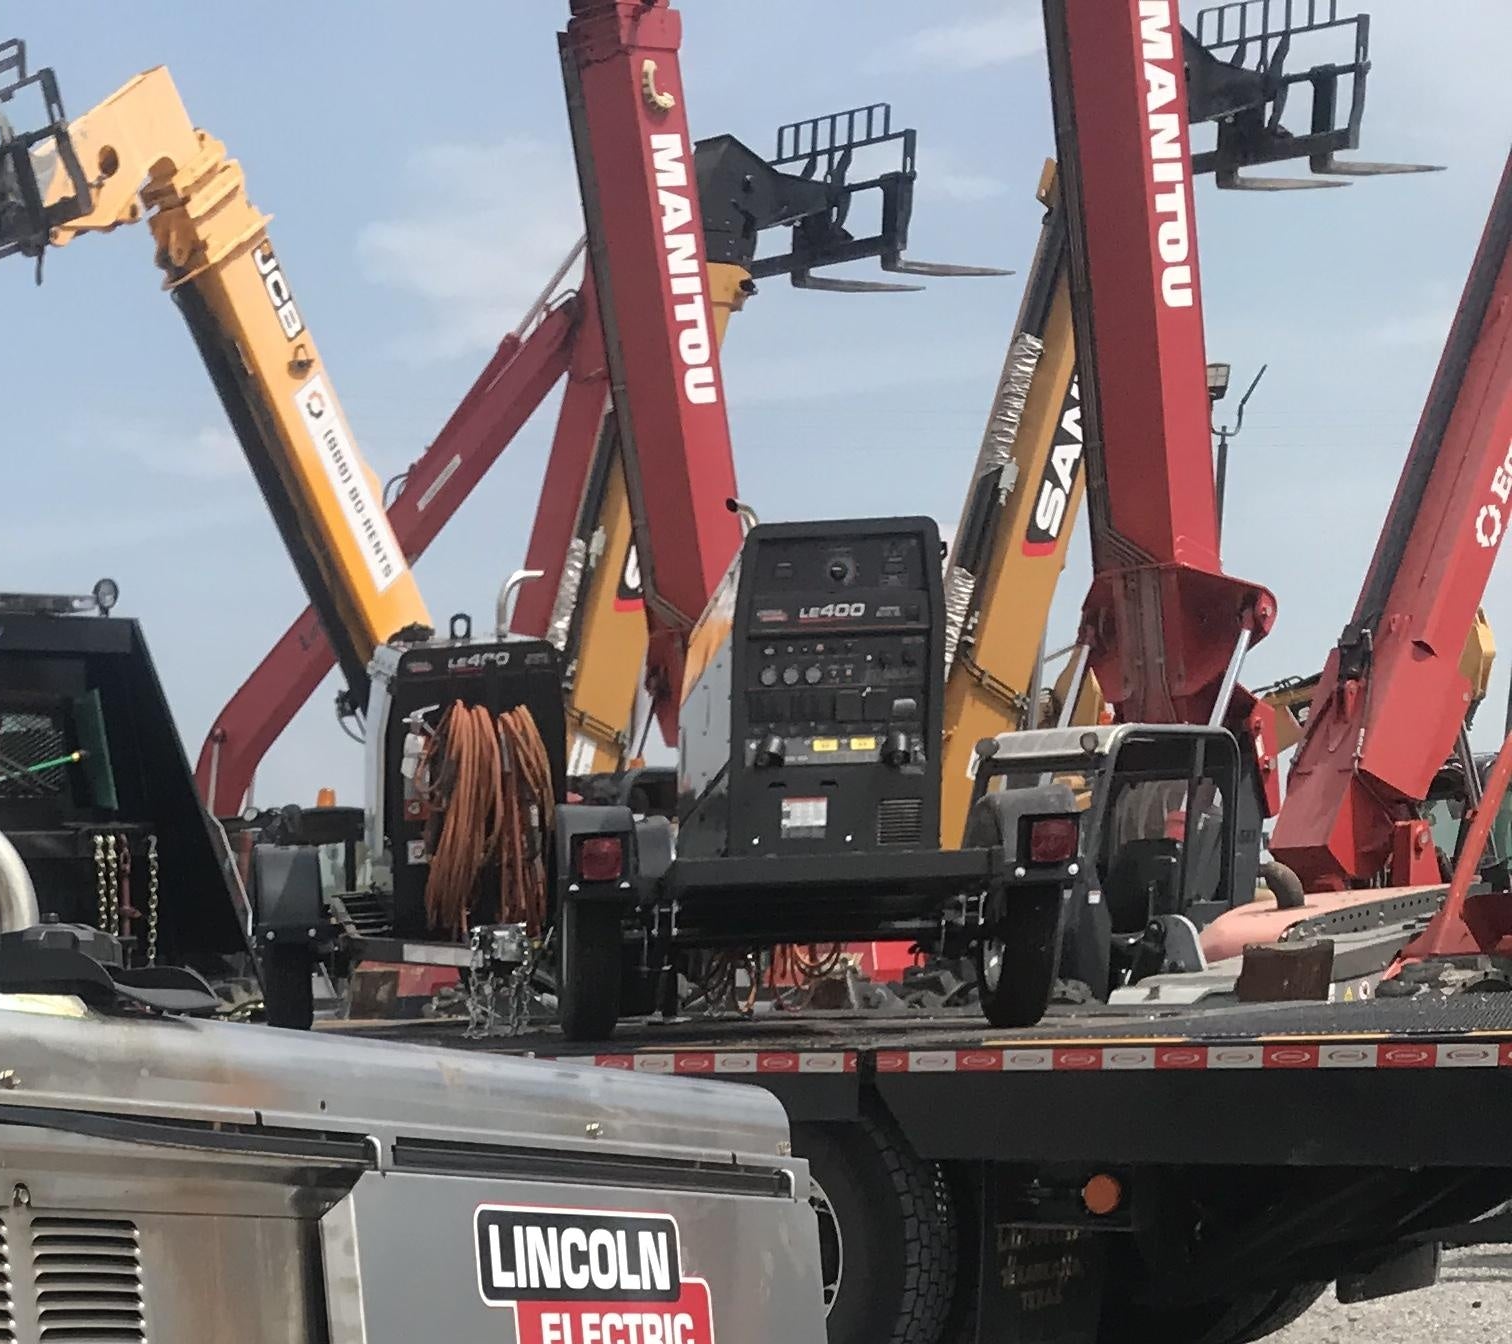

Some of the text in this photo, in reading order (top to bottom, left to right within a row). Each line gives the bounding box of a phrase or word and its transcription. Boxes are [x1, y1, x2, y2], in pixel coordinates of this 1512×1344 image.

[1138, 0, 1193, 308] MANITOU
[252, 245, 305, 342] JCB
[650, 133, 718, 405] MANITOU
[1035, 373, 1084, 539] SAN
[798, 602, 866, 619] LE400
[488, 1223, 671, 1291] LINCOLN
